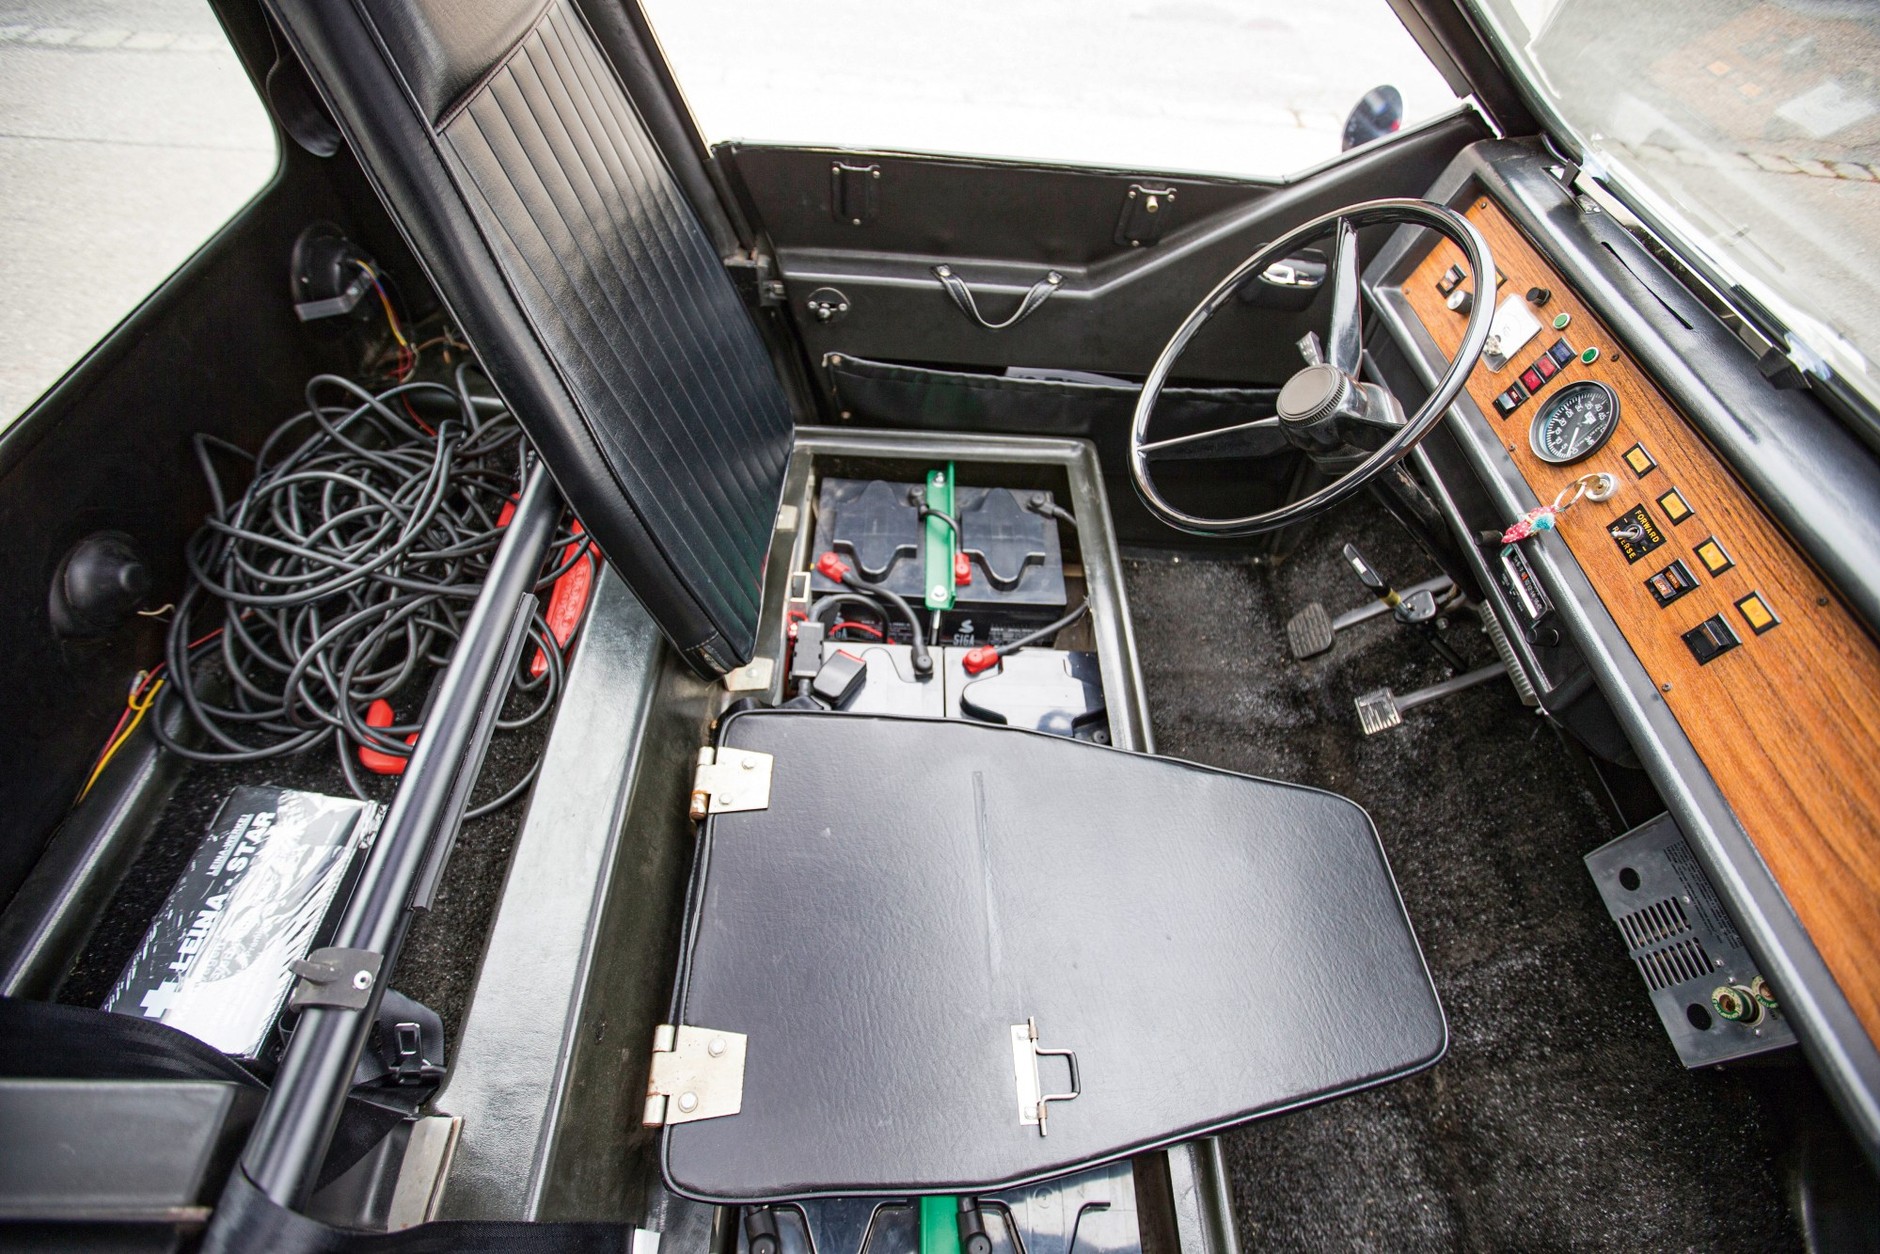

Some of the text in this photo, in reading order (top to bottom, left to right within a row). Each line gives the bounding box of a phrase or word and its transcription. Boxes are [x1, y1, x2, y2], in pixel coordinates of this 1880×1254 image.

[1612, 526, 1636, 559] RERSE
[1634, 509, 1660, 543] FORWARD
[953, 633, 975, 646] SIGA
[168, 892, 229, 973] LEINA
[226, 811, 276, 873] STAR
